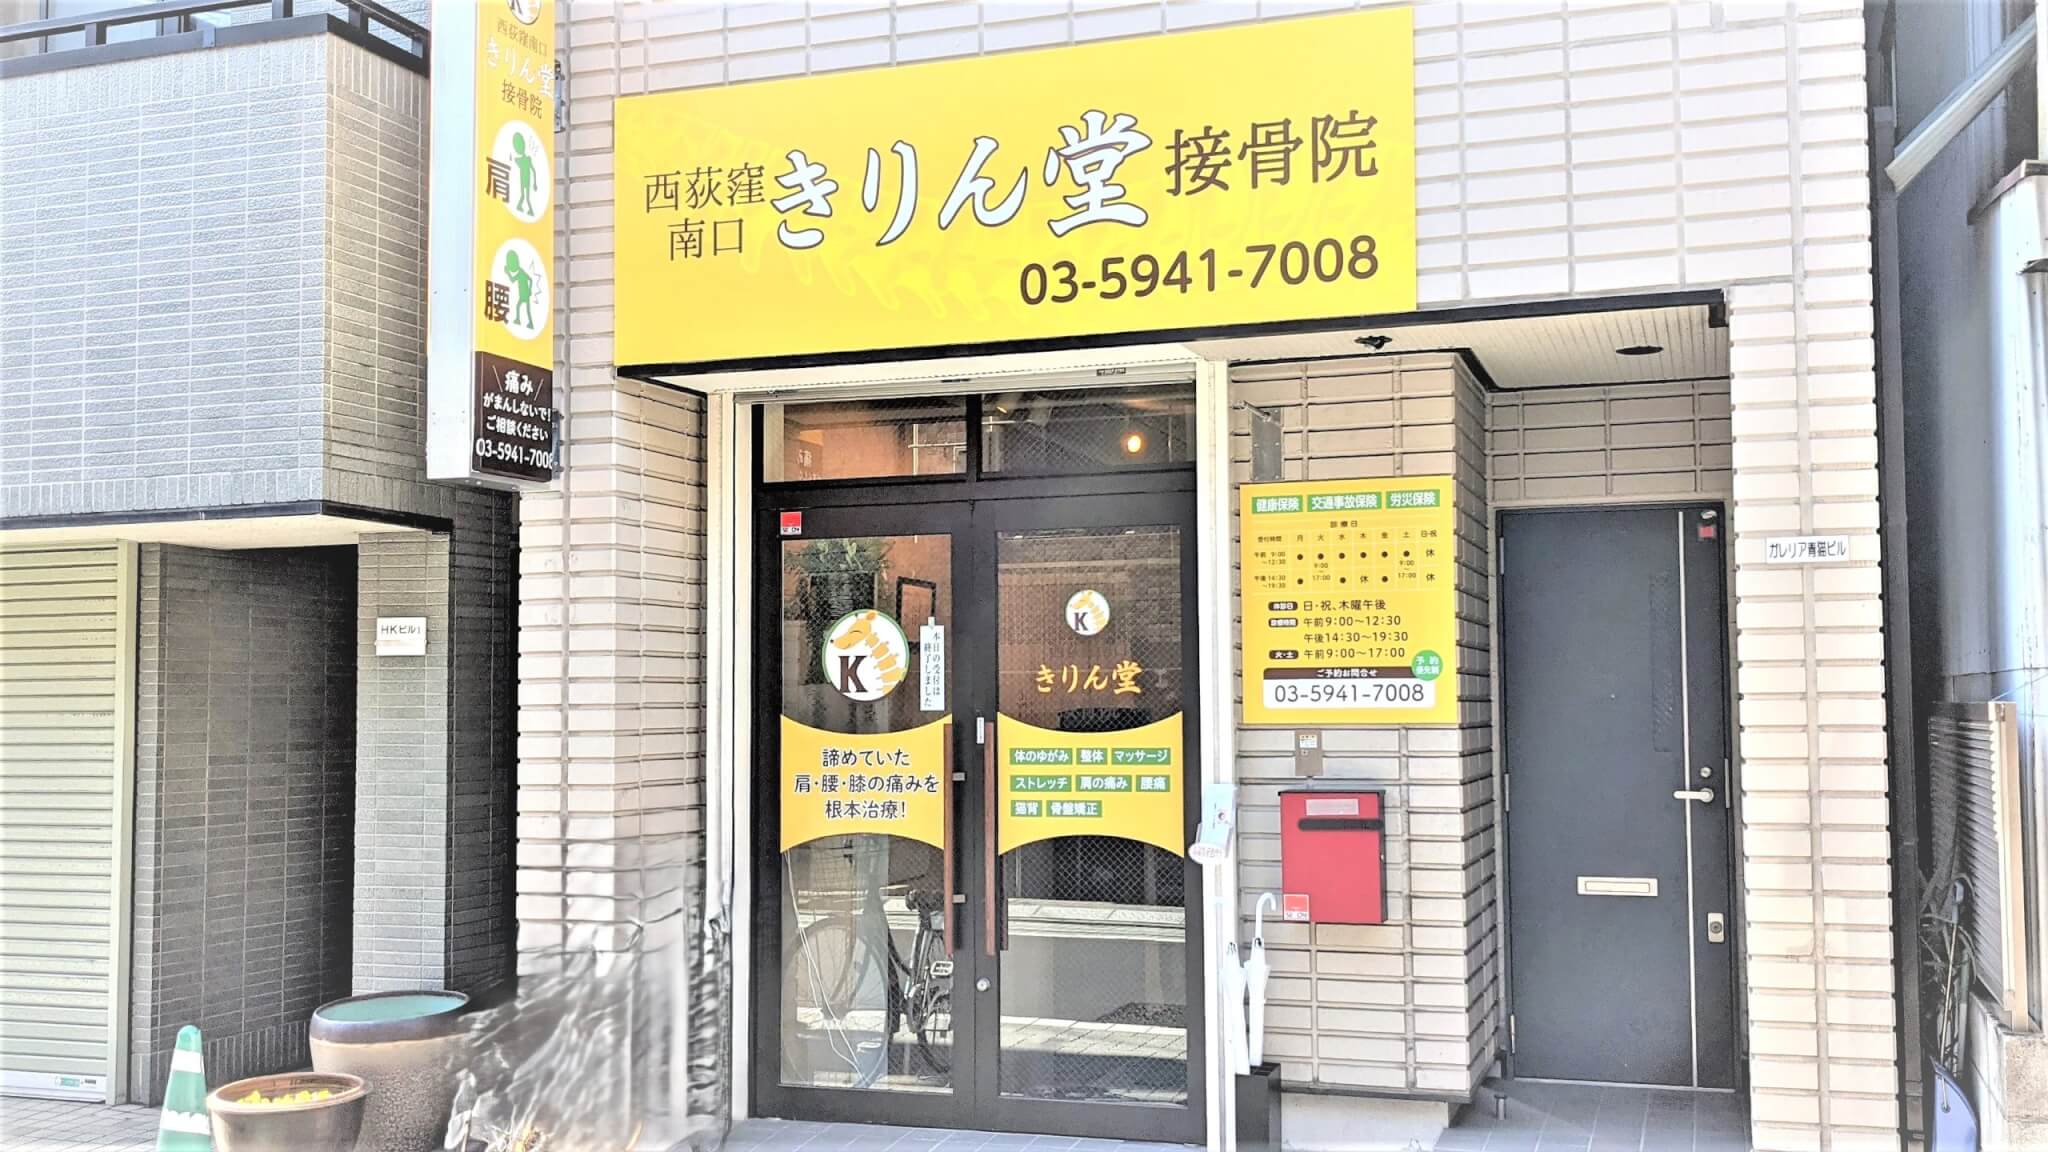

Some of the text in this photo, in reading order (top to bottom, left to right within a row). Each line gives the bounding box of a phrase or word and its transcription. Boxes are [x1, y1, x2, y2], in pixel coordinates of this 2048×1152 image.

[486, 35, 555, 100] きりん堂
[501, 80, 543, 120] 接骨院
[486, 157, 511, 203] 肩
[644, 162, 766, 214] 西荻窪
[770, 108, 1379, 250] きりん堂 接骨院
[667, 217, 745, 262] 南口
[1020, 235, 1379, 305] 03-5941-7008
[484, 280, 511, 324] 腰
[504, 370, 534, 396] 痛み
[486, 414, 549, 441] ご相談ください
[1256, 491, 1437, 512] 健康保険 交通事故保険 労災保険
[1425, 548, 1435, 558] 休
[1425, 573, 1436, 582] 休
[1073, 611, 1089, 632] K
[838, 655, 868, 693] K
[1035, 660, 1144, 696] きりん堂
[1274, 683, 1425, 703] 03-5941-7008
[822, 748, 911, 768] 諦めていた
[1013, 749, 1168, 763] 体のゆがみ 整体 マッサージ
[1014, 776, 1166, 790] ストレッチ 肩の痛み 腰痛
